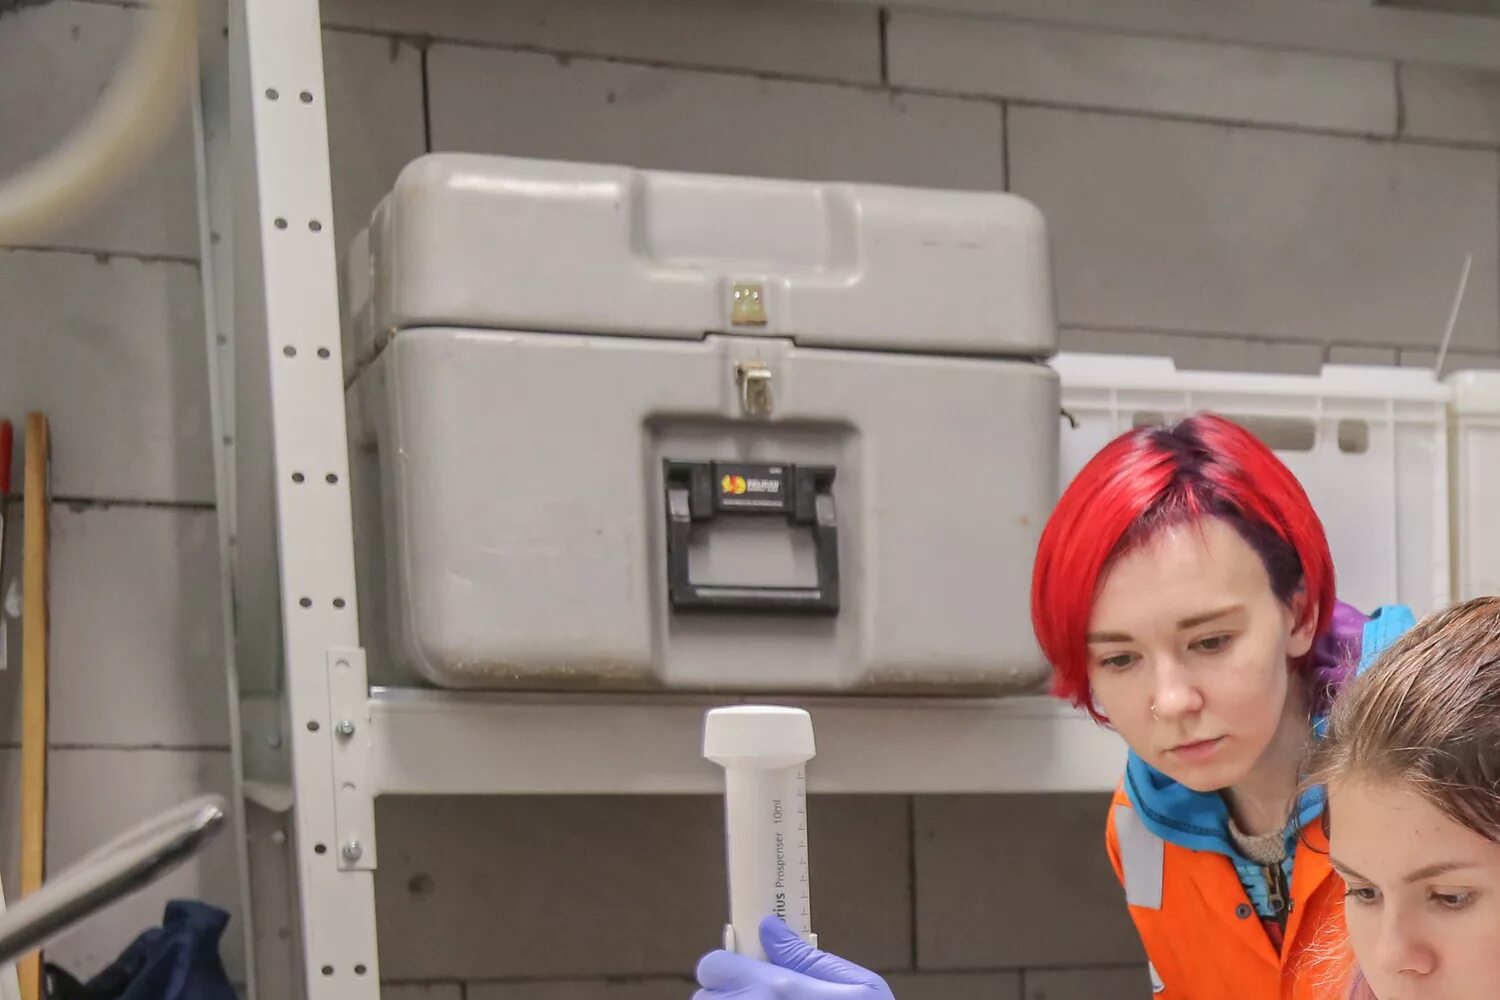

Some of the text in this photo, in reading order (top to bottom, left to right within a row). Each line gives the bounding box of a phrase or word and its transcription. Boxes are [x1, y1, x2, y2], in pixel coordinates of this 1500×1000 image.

[772, 800, 786, 923] rius Prospenser 10ml
